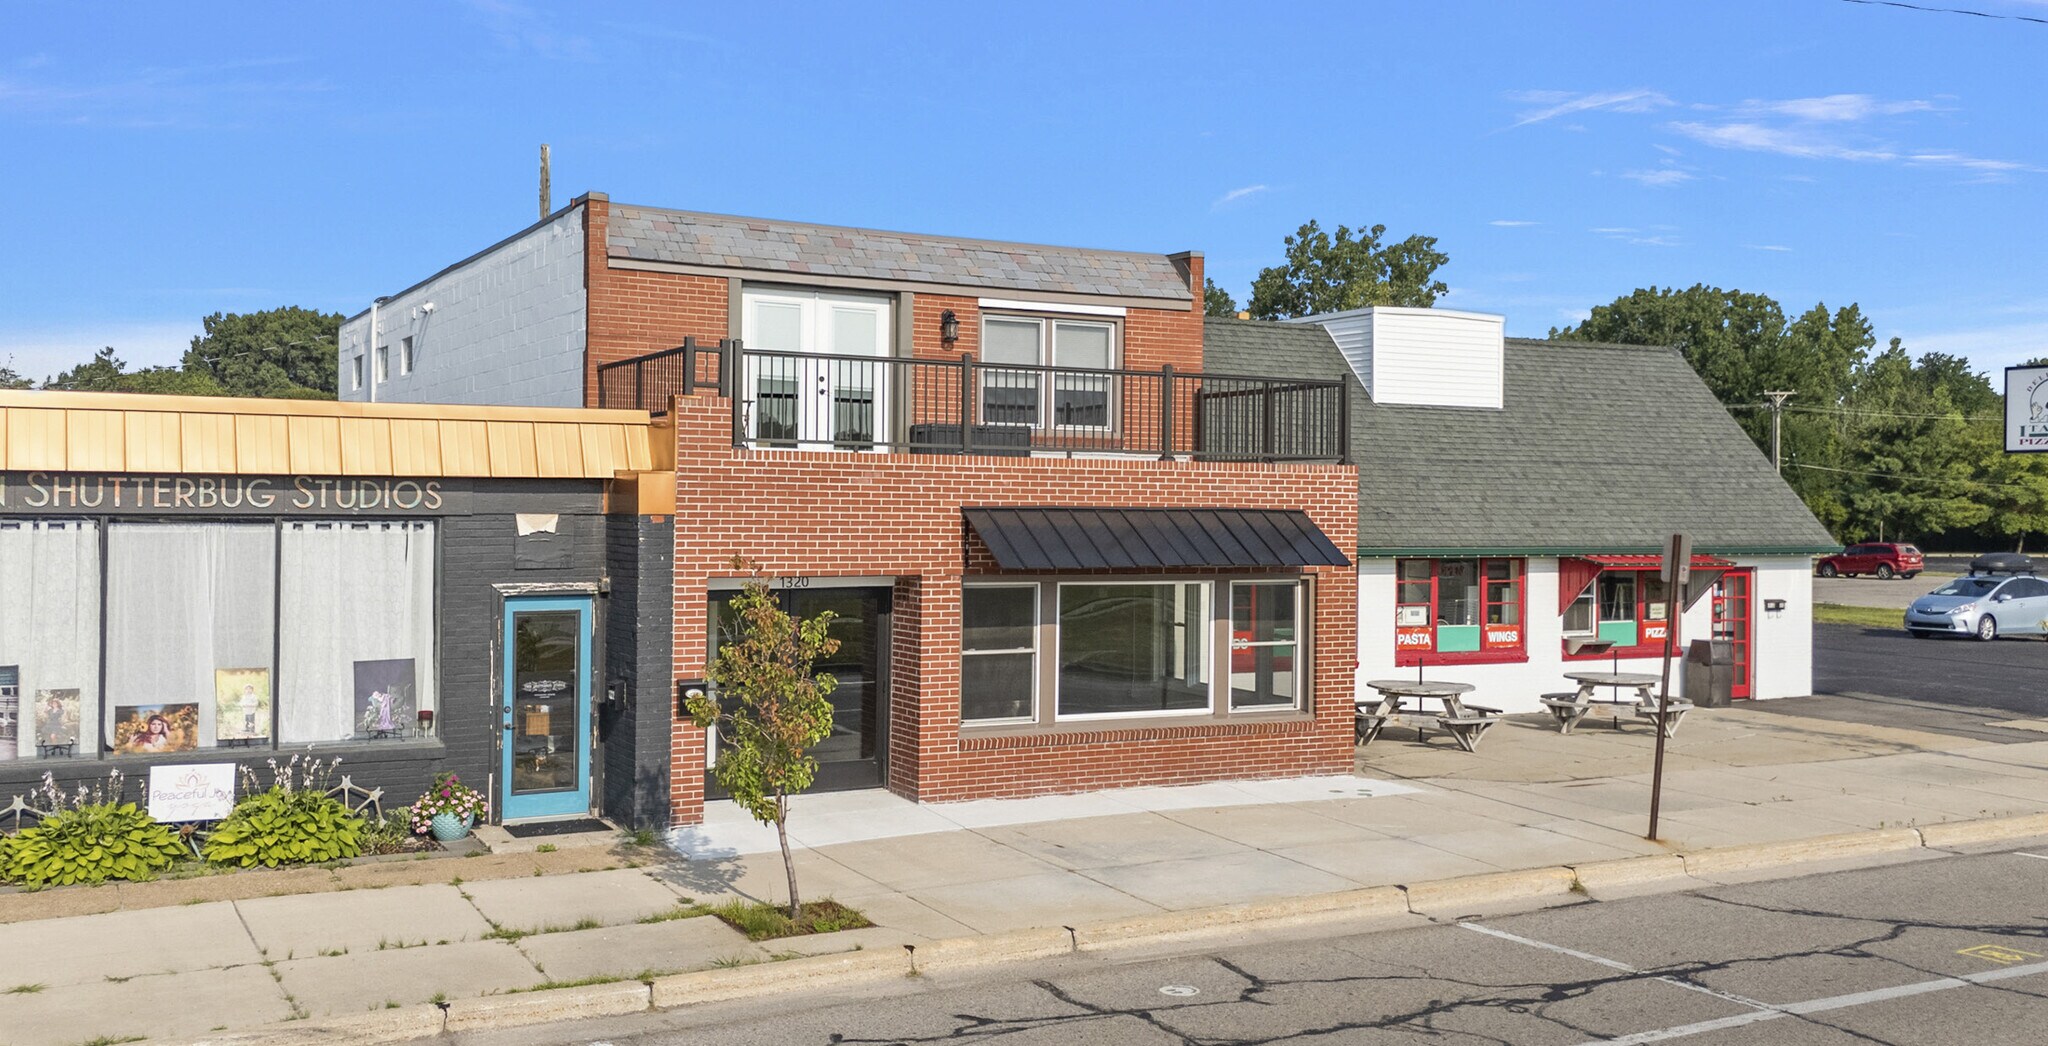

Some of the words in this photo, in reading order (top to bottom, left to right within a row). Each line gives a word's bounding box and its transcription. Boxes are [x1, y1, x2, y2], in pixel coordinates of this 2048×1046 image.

[24, 471, 276, 508] SHUTTERBUG
[292, 475, 443, 509] STUDIOS
[780, 576, 809, 588] 1320
[1397, 632, 1431, 646] PASTA
[1487, 630, 1518, 643] WINGS
[1645, 626, 1667, 639] PIZZ
[152, 787, 207, 801] Peaceful
